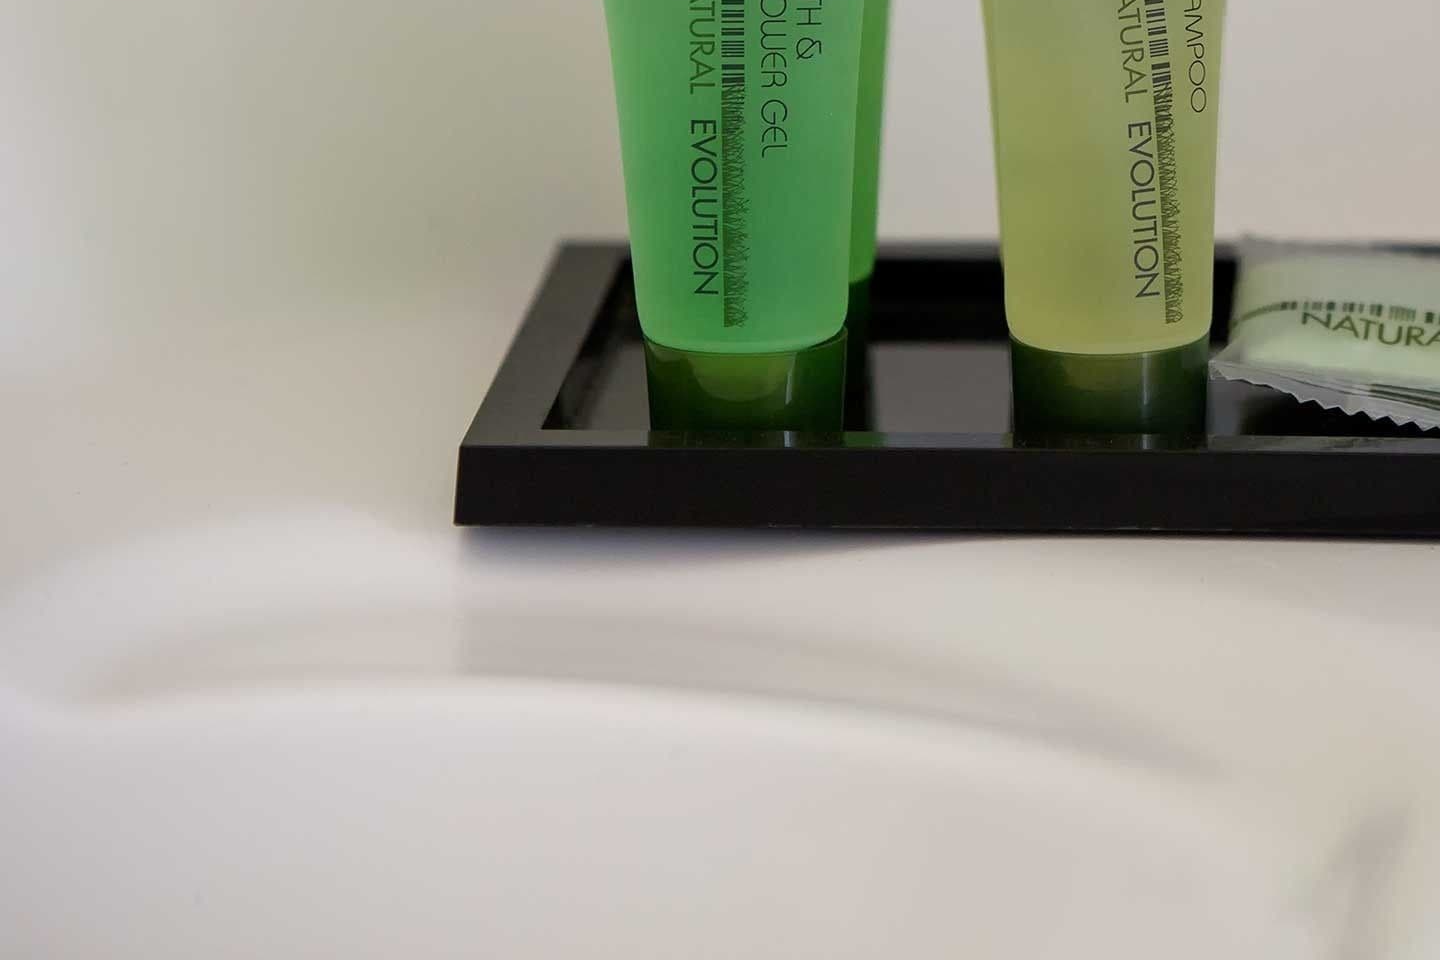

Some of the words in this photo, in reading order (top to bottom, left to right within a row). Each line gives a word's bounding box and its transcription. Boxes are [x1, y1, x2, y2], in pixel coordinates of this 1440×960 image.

[796, 37, 823, 60] &
[760, 99, 788, 158] GEL
[690, 119, 720, 295] EVOLUTION
[1128, 121, 1160, 298] EVOLUTION
